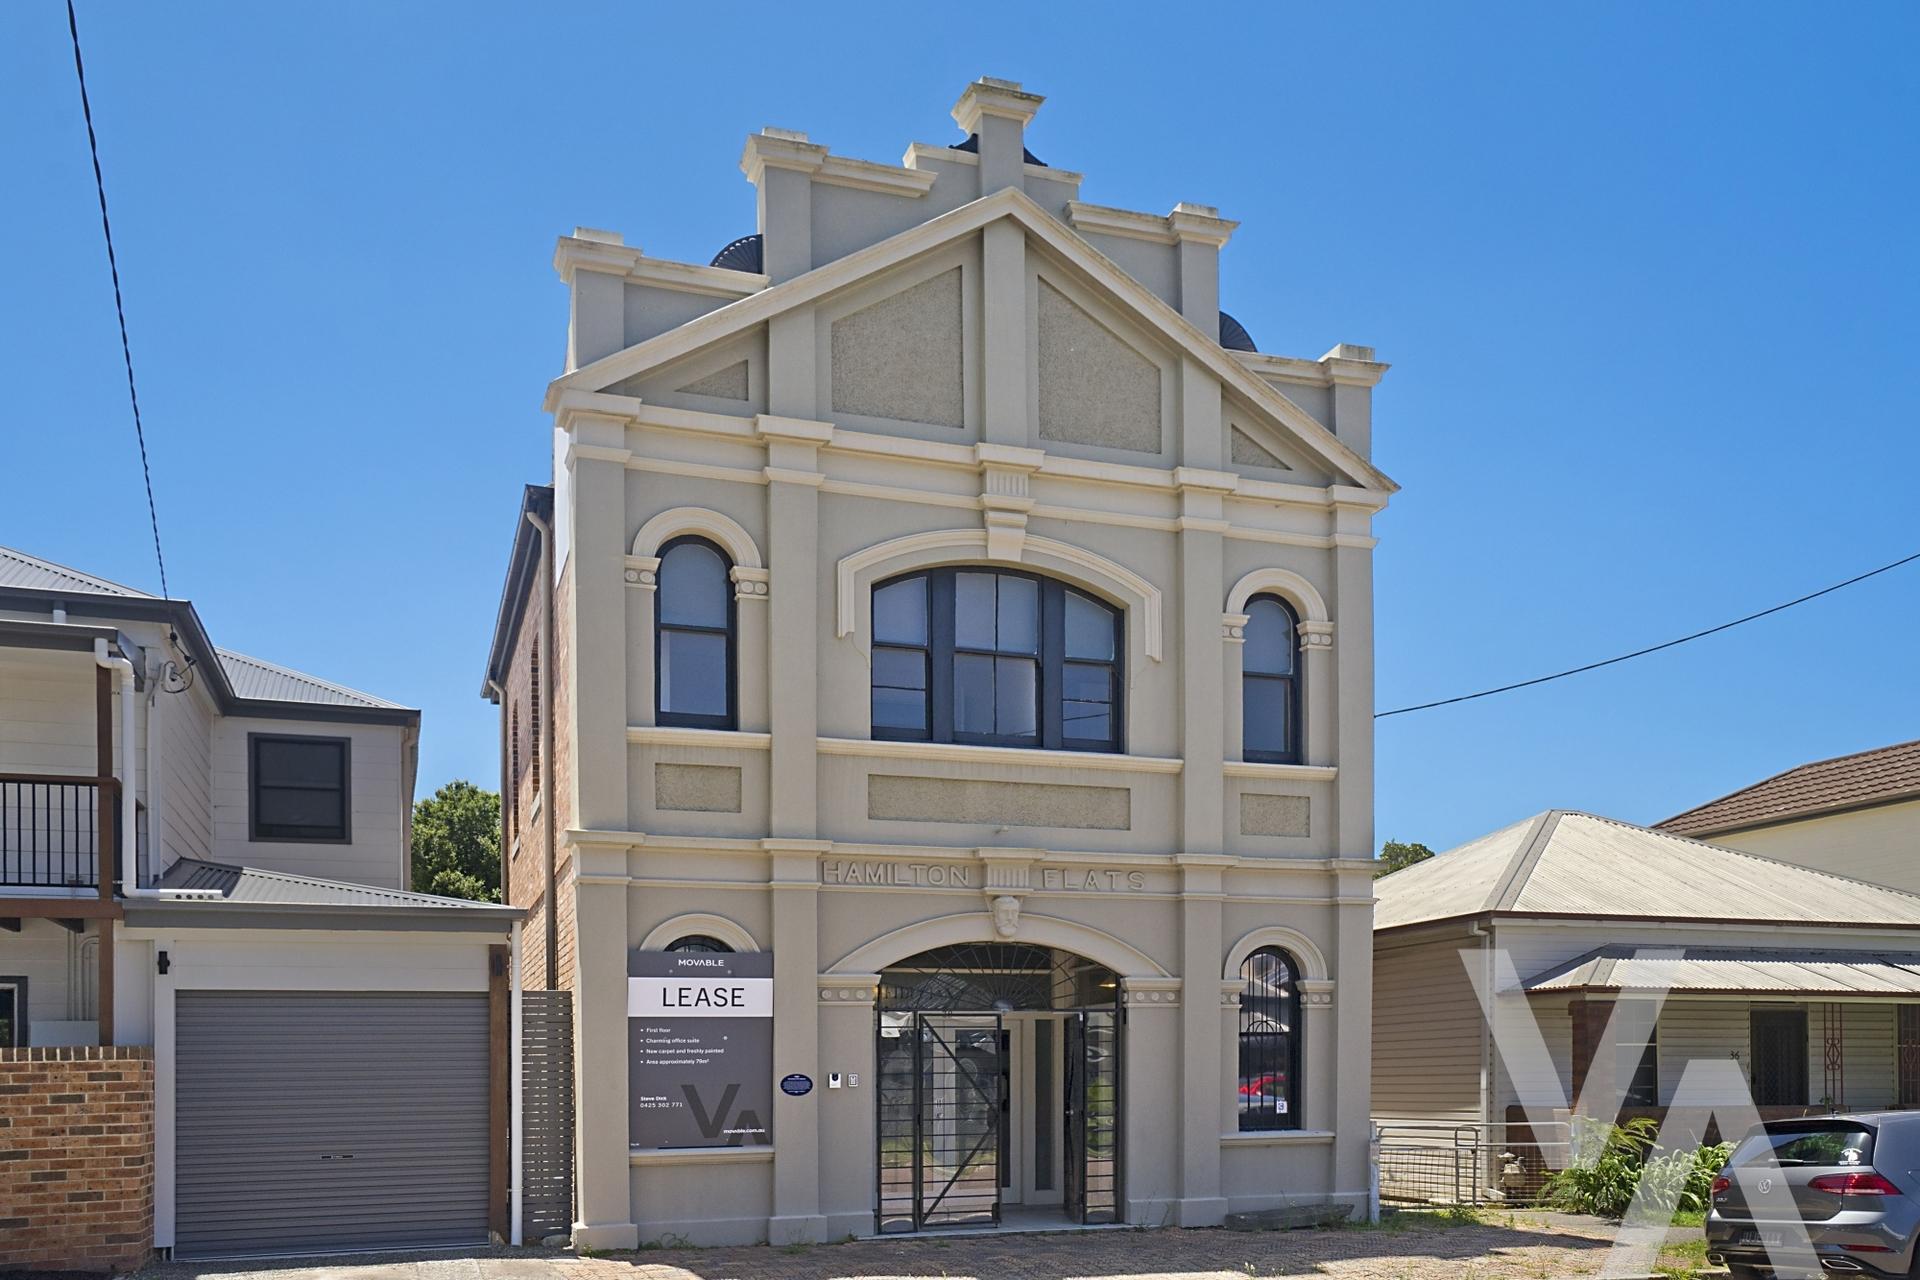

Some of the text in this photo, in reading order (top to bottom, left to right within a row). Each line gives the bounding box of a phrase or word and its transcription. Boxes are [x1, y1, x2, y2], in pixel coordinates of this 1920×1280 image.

[822, 861, 1146, 891] HAMILTON FLATS
[678, 959, 725, 967] MOVABLE
[663, 987, 745, 1007] LEASE
[1729, 1050, 1740, 1060] 36
